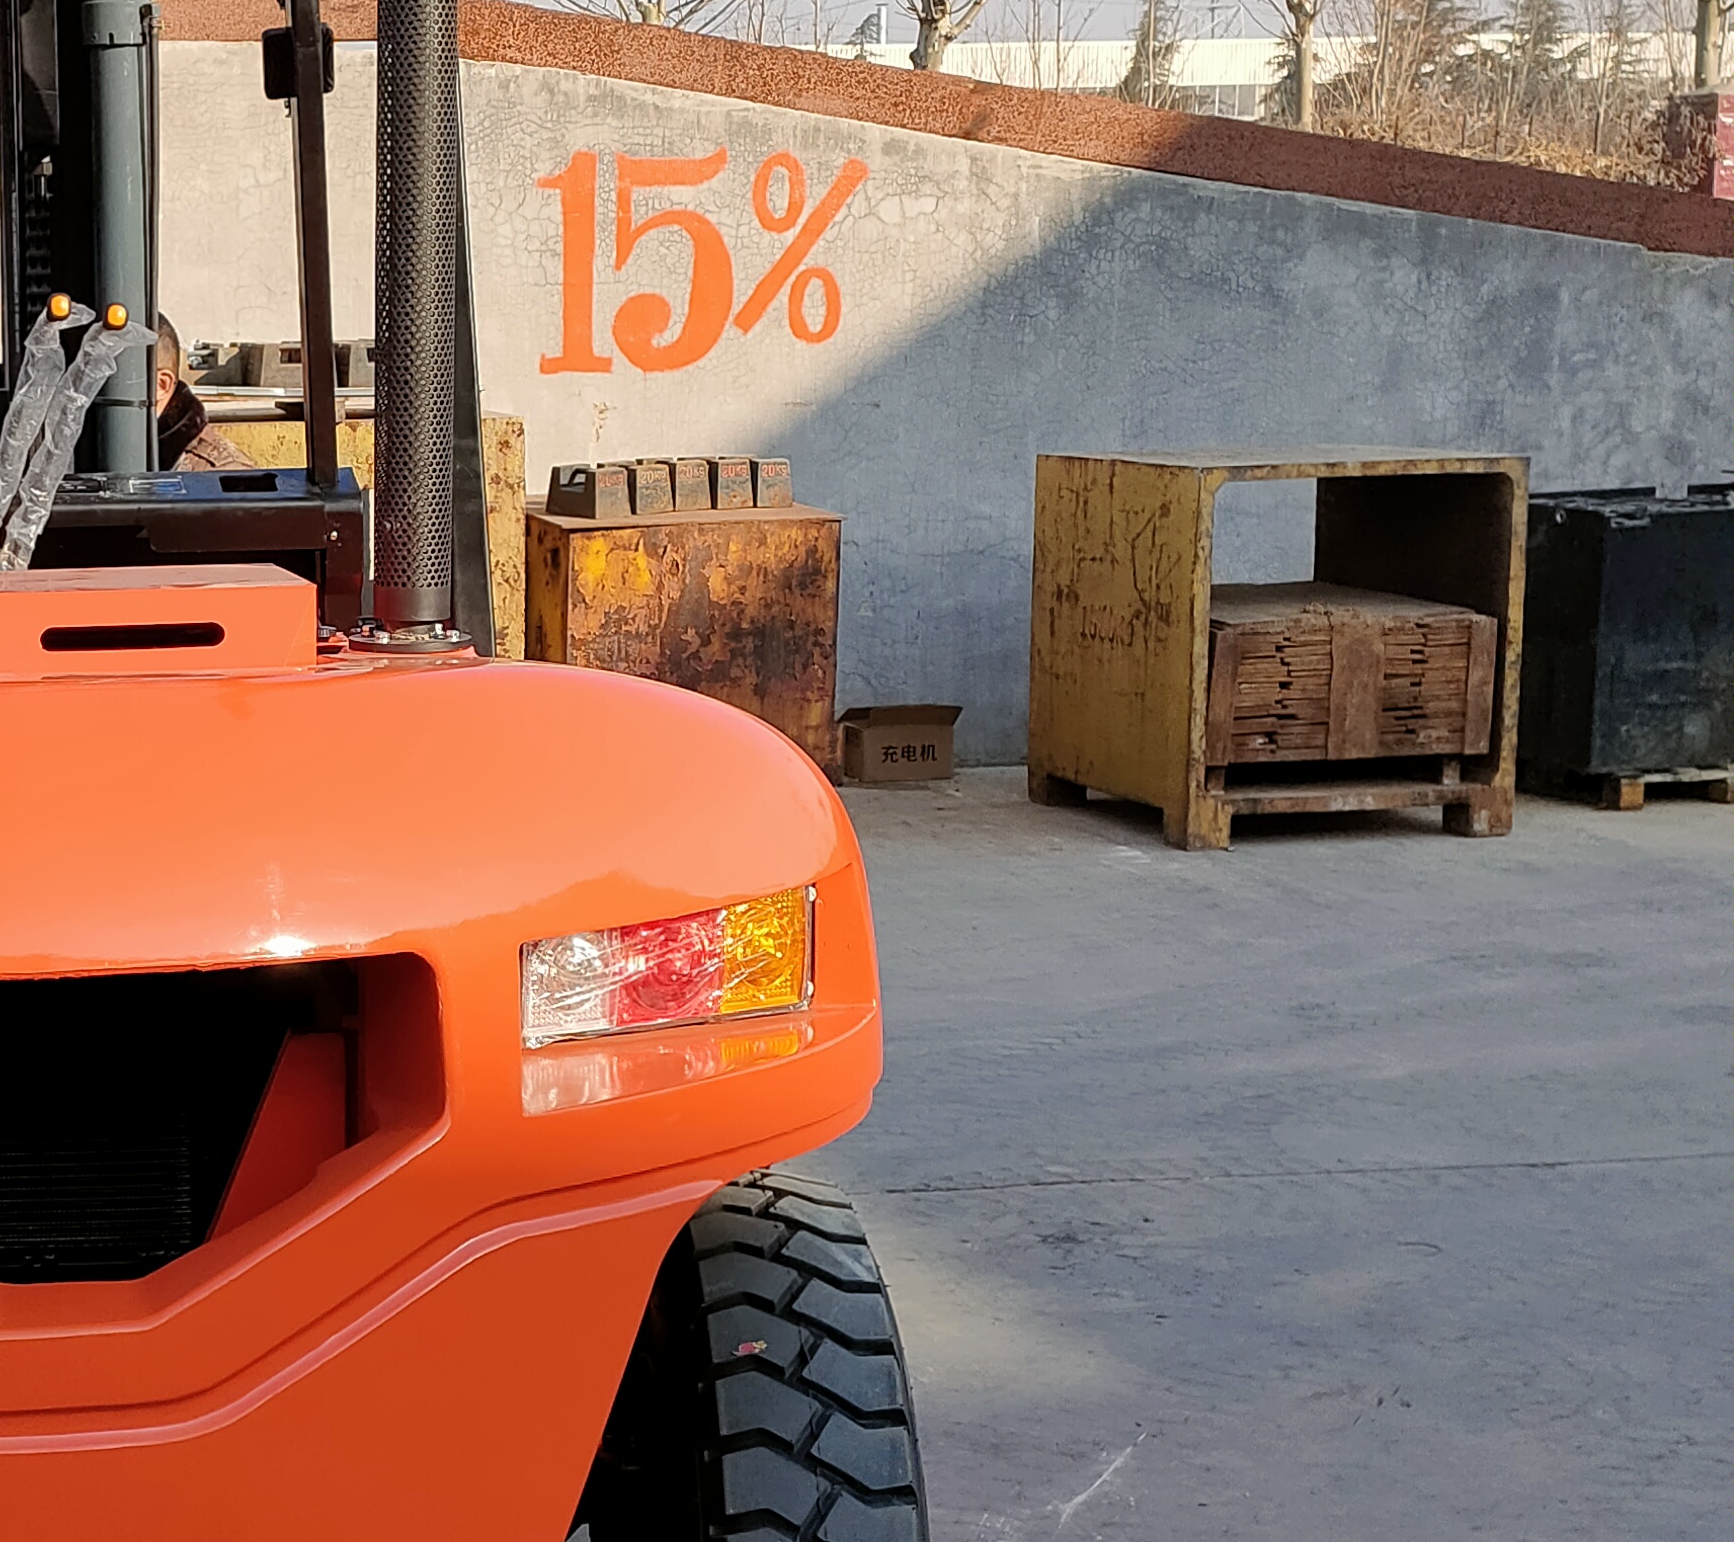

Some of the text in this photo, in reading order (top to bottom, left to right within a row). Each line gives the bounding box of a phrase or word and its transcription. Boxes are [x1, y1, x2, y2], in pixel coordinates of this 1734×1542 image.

[536, 146, 869, 373] 15%
[881, 744, 937, 763] 充电机
